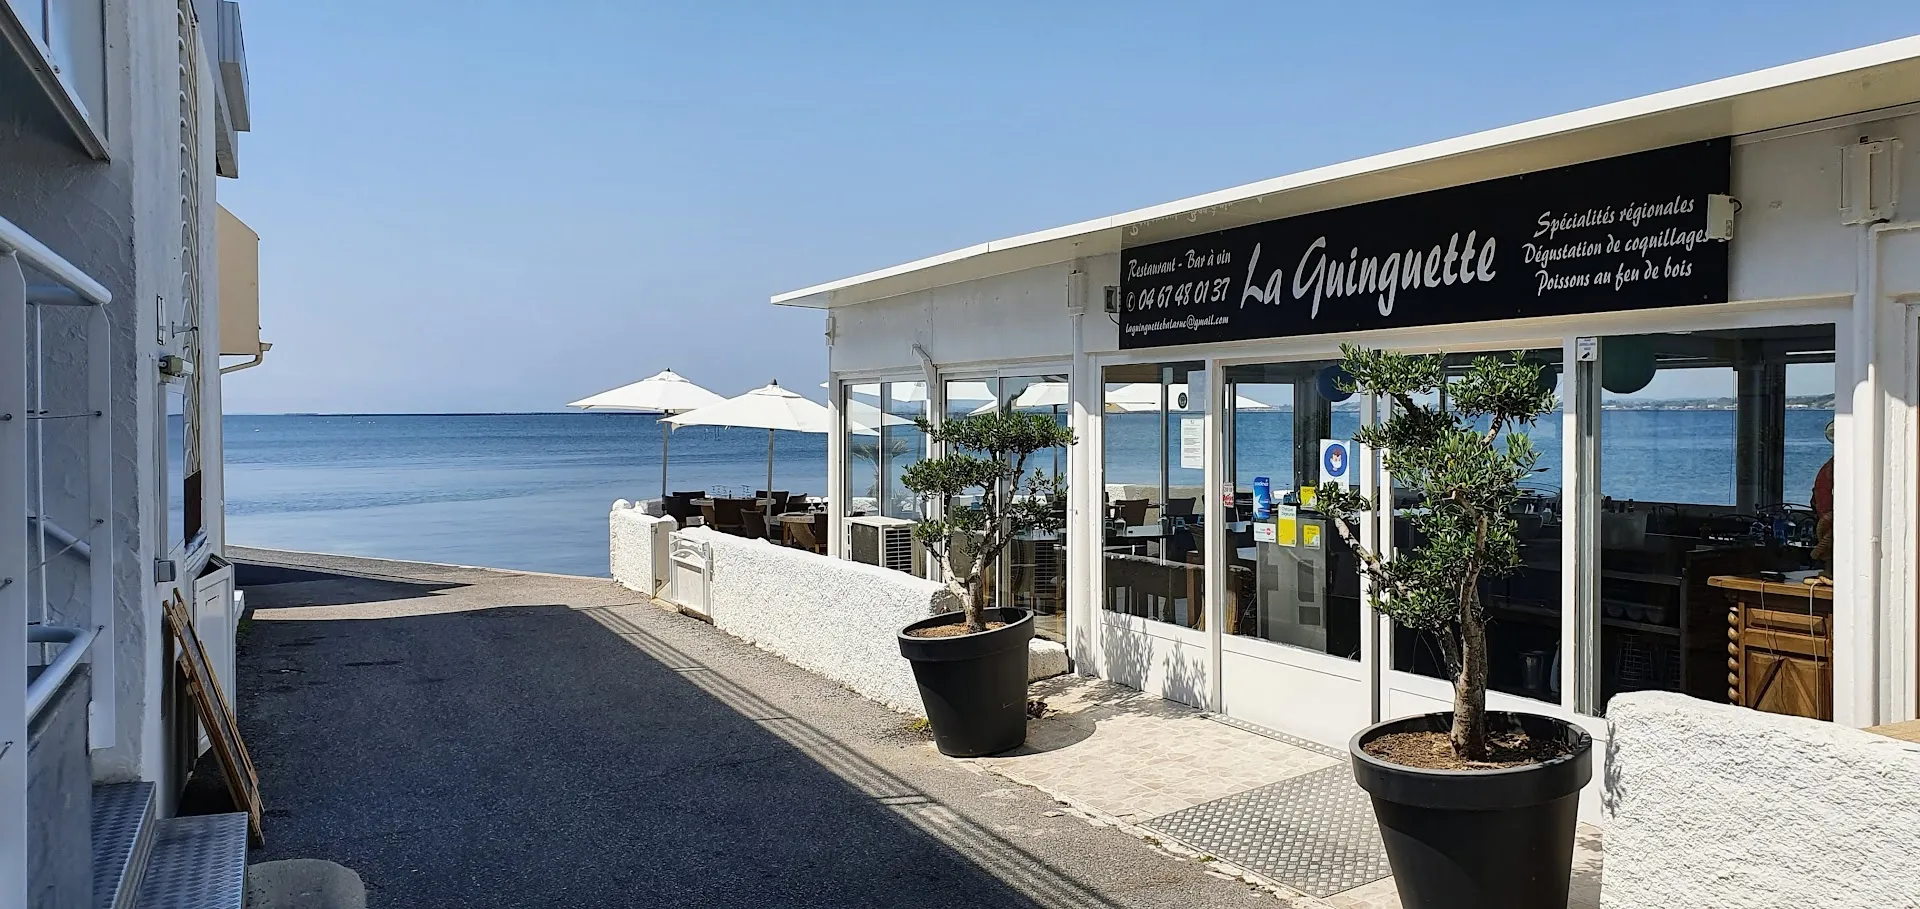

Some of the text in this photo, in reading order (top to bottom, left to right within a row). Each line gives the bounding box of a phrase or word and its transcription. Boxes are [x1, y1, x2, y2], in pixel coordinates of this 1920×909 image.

[1533, 195, 1695, 240] Spécialités régionales
[1128, 258, 1176, 281] Restaurant
[1185, 249, 1205, 269] Bar
[1207, 249, 1214, 266] à
[1217, 249, 1231, 264] vin
[1521, 227, 1709, 268] Dégustation de coquillages
[1138, 277, 1230, 311] 04 67 48 01 37
[1240, 229, 1496, 320] La Guinguette
[1534, 256, 1693, 296] Poissons au feu de bois
